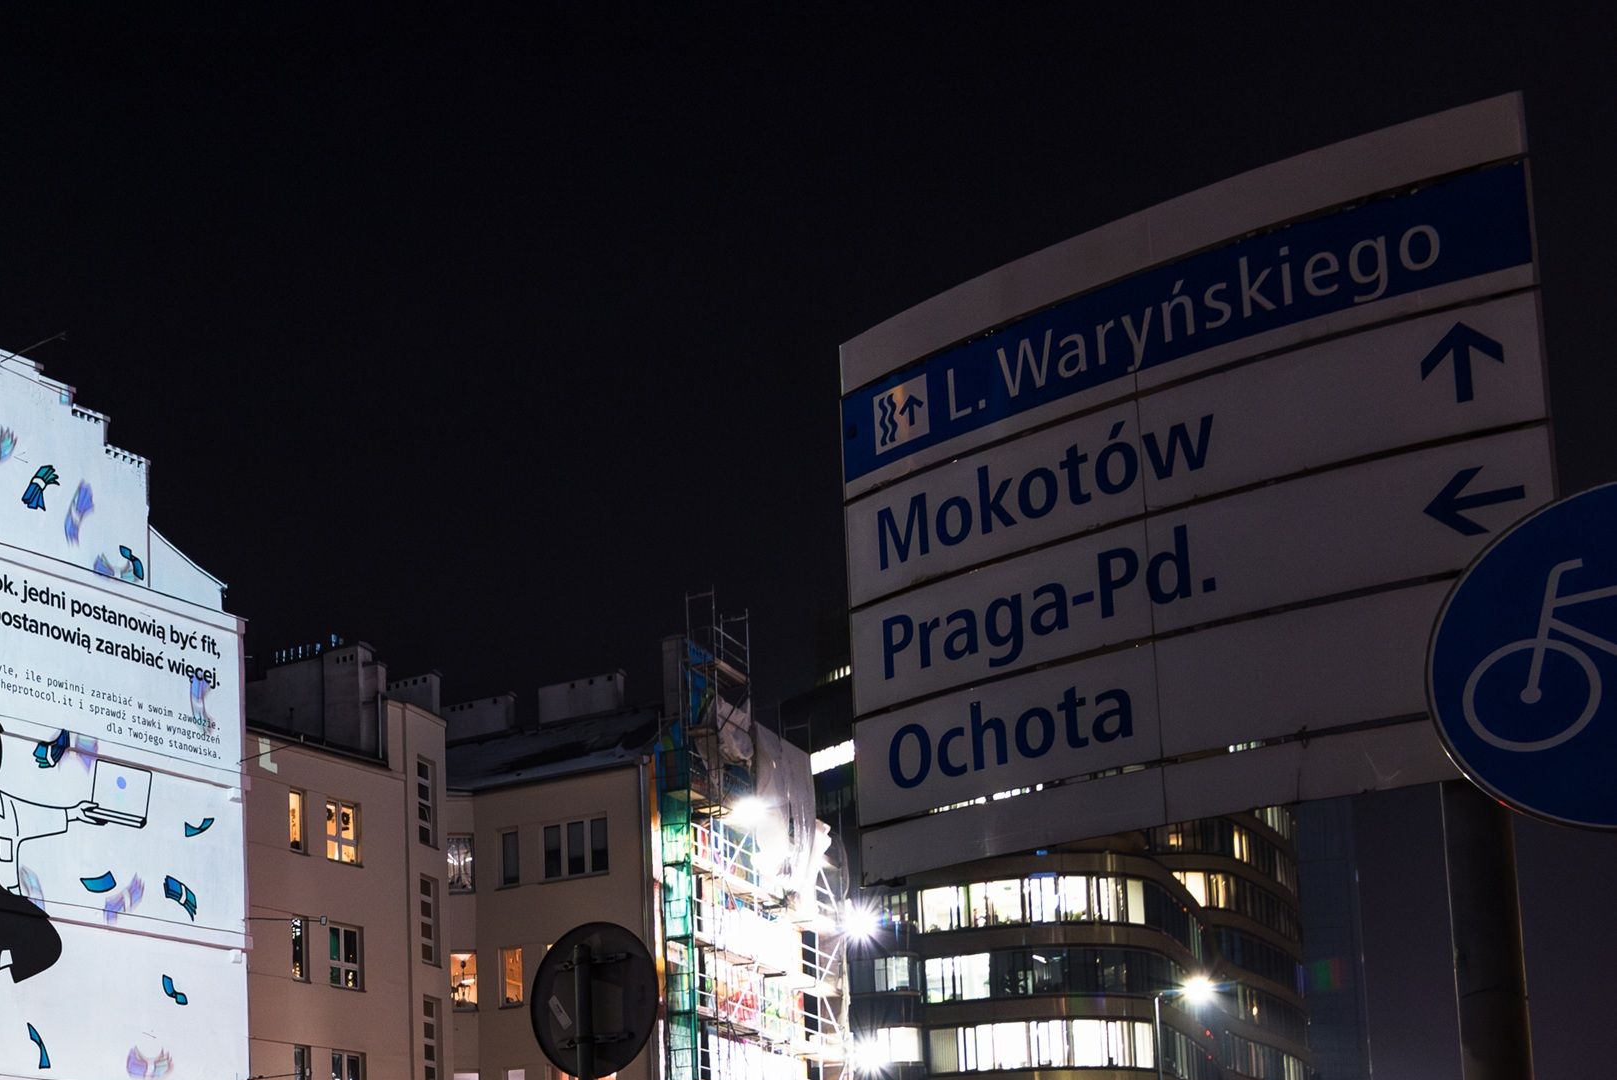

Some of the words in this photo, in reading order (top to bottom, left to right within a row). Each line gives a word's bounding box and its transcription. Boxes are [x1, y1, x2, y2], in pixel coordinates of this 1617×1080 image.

[946, 367, 987, 422] L.
[996, 223, 1442, 399] Waryńskiego
[877, 413, 1214, 572] Mokotów
[21, 580, 66, 611] jedni
[71, 598, 167, 645] postanowią
[170, 624, 197, 651] być
[200, 635, 221, 659] fit,
[882, 524, 1217, 681] Praga-Pd.
[25, 669, 42, 683] ile
[47, 677, 85, 695] powinni
[90, 688, 133, 708] zarabiać
[137, 701, 144, 711] w
[148, 704, 173, 718] swoim
[178, 712, 221, 731] zawodzie.
[95, 636, 164, 671] zarabiać
[167, 658, 221, 690] więcej.
[79, 699, 84, 710] i
[89, 703, 126, 721] sprawdź
[131, 713, 162, 730] stawki
[166, 724, 221, 745] wynagrodzeń
[106, 723, 123, 735] dla
[128, 727, 164, 746] Twojego
[168, 739, 221, 760] stanowiska.
[888, 686, 1134, 789] Ochota
